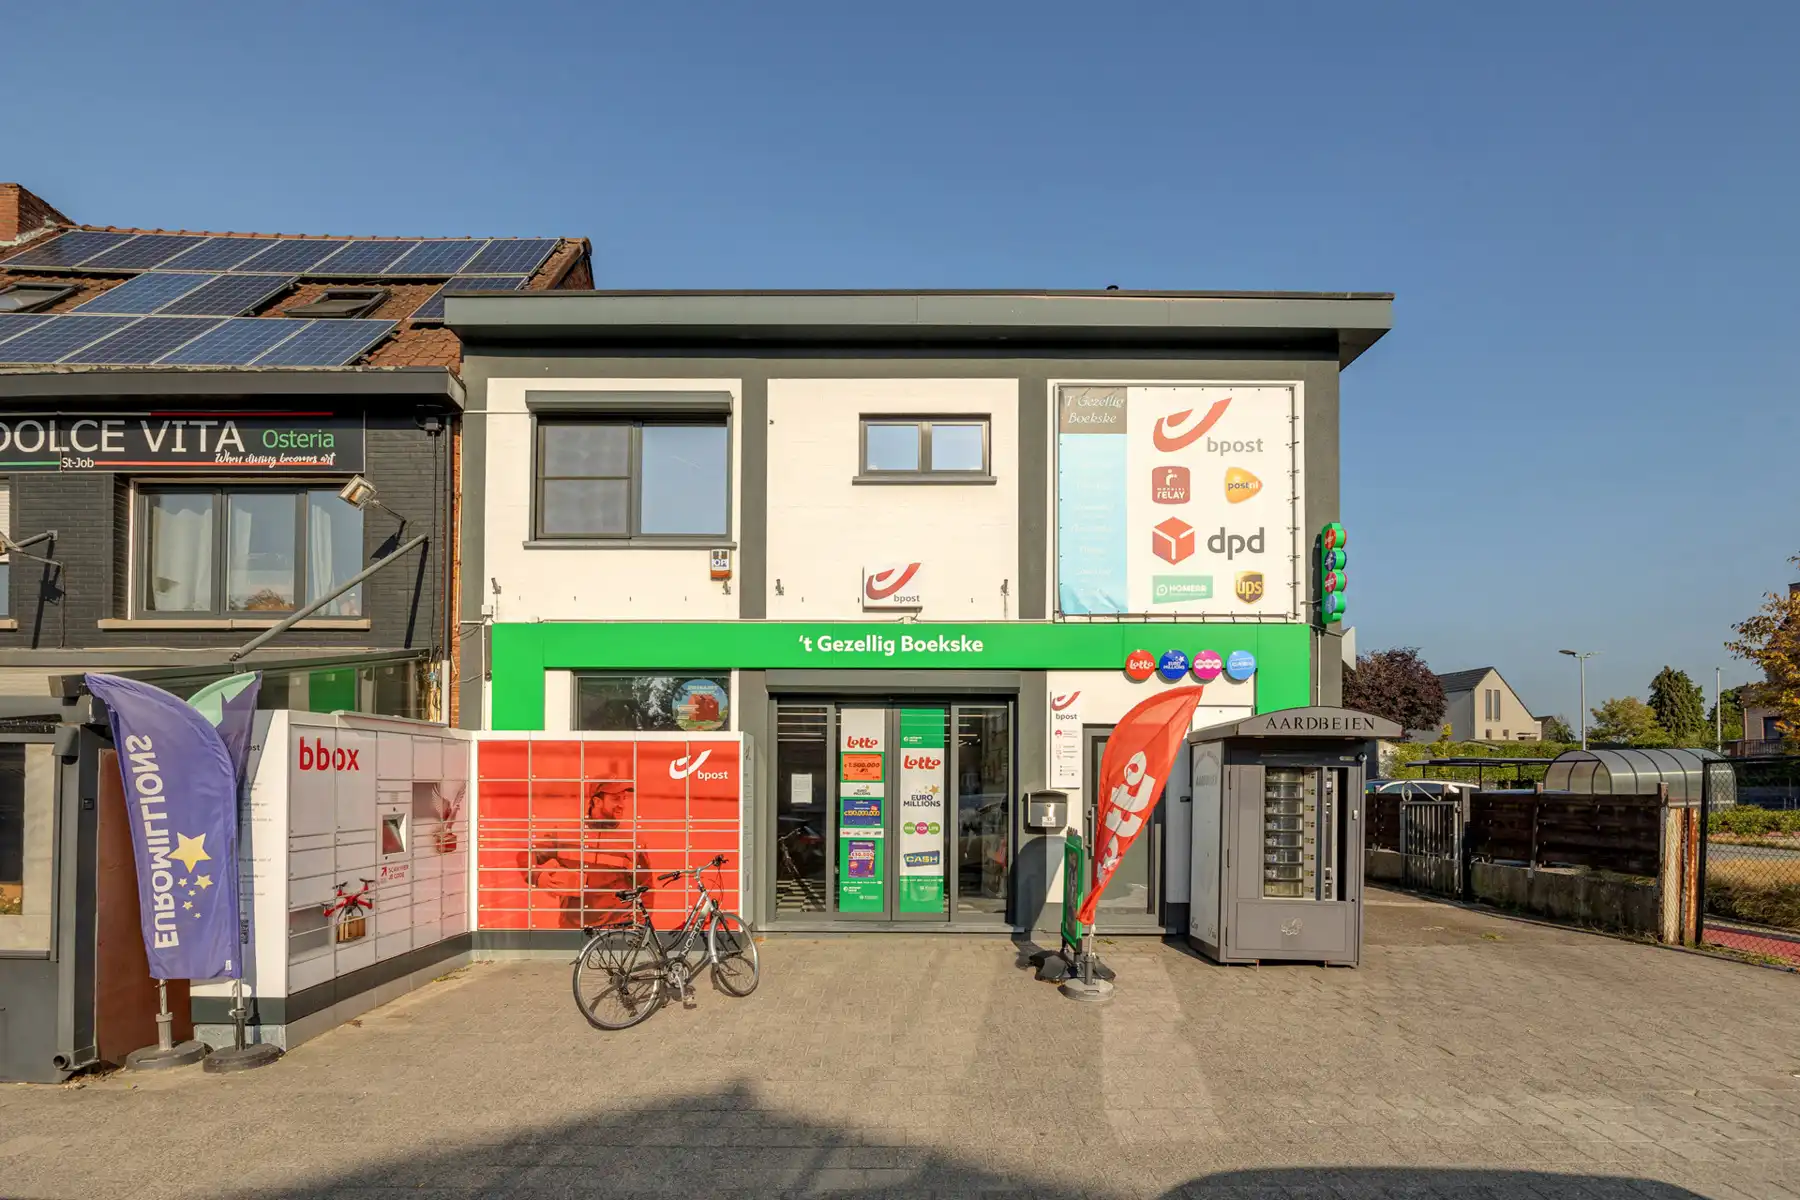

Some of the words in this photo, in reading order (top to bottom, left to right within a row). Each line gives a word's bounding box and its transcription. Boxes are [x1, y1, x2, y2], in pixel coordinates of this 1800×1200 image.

[1068, 411, 1118, 424] Boekske
[140, 420, 245, 452] VITA
[262, 429, 334, 448] Osteria
[1207, 436, 1264, 456] bpost
[61, 457, 94, 468] St-Job
[1207, 527, 1265, 560] dpd
[893, 594, 920, 604] bpost
[1236, 580, 1262, 600] ups
[817, 635, 895, 656] Gezellig
[901, 635, 984, 652] Boekske
[1266, 717, 1375, 730] AARDBEIEN
[299, 736, 360, 771] bbox
[697, 770, 728, 781] bpost
[905, 855, 938, 863] CASH
